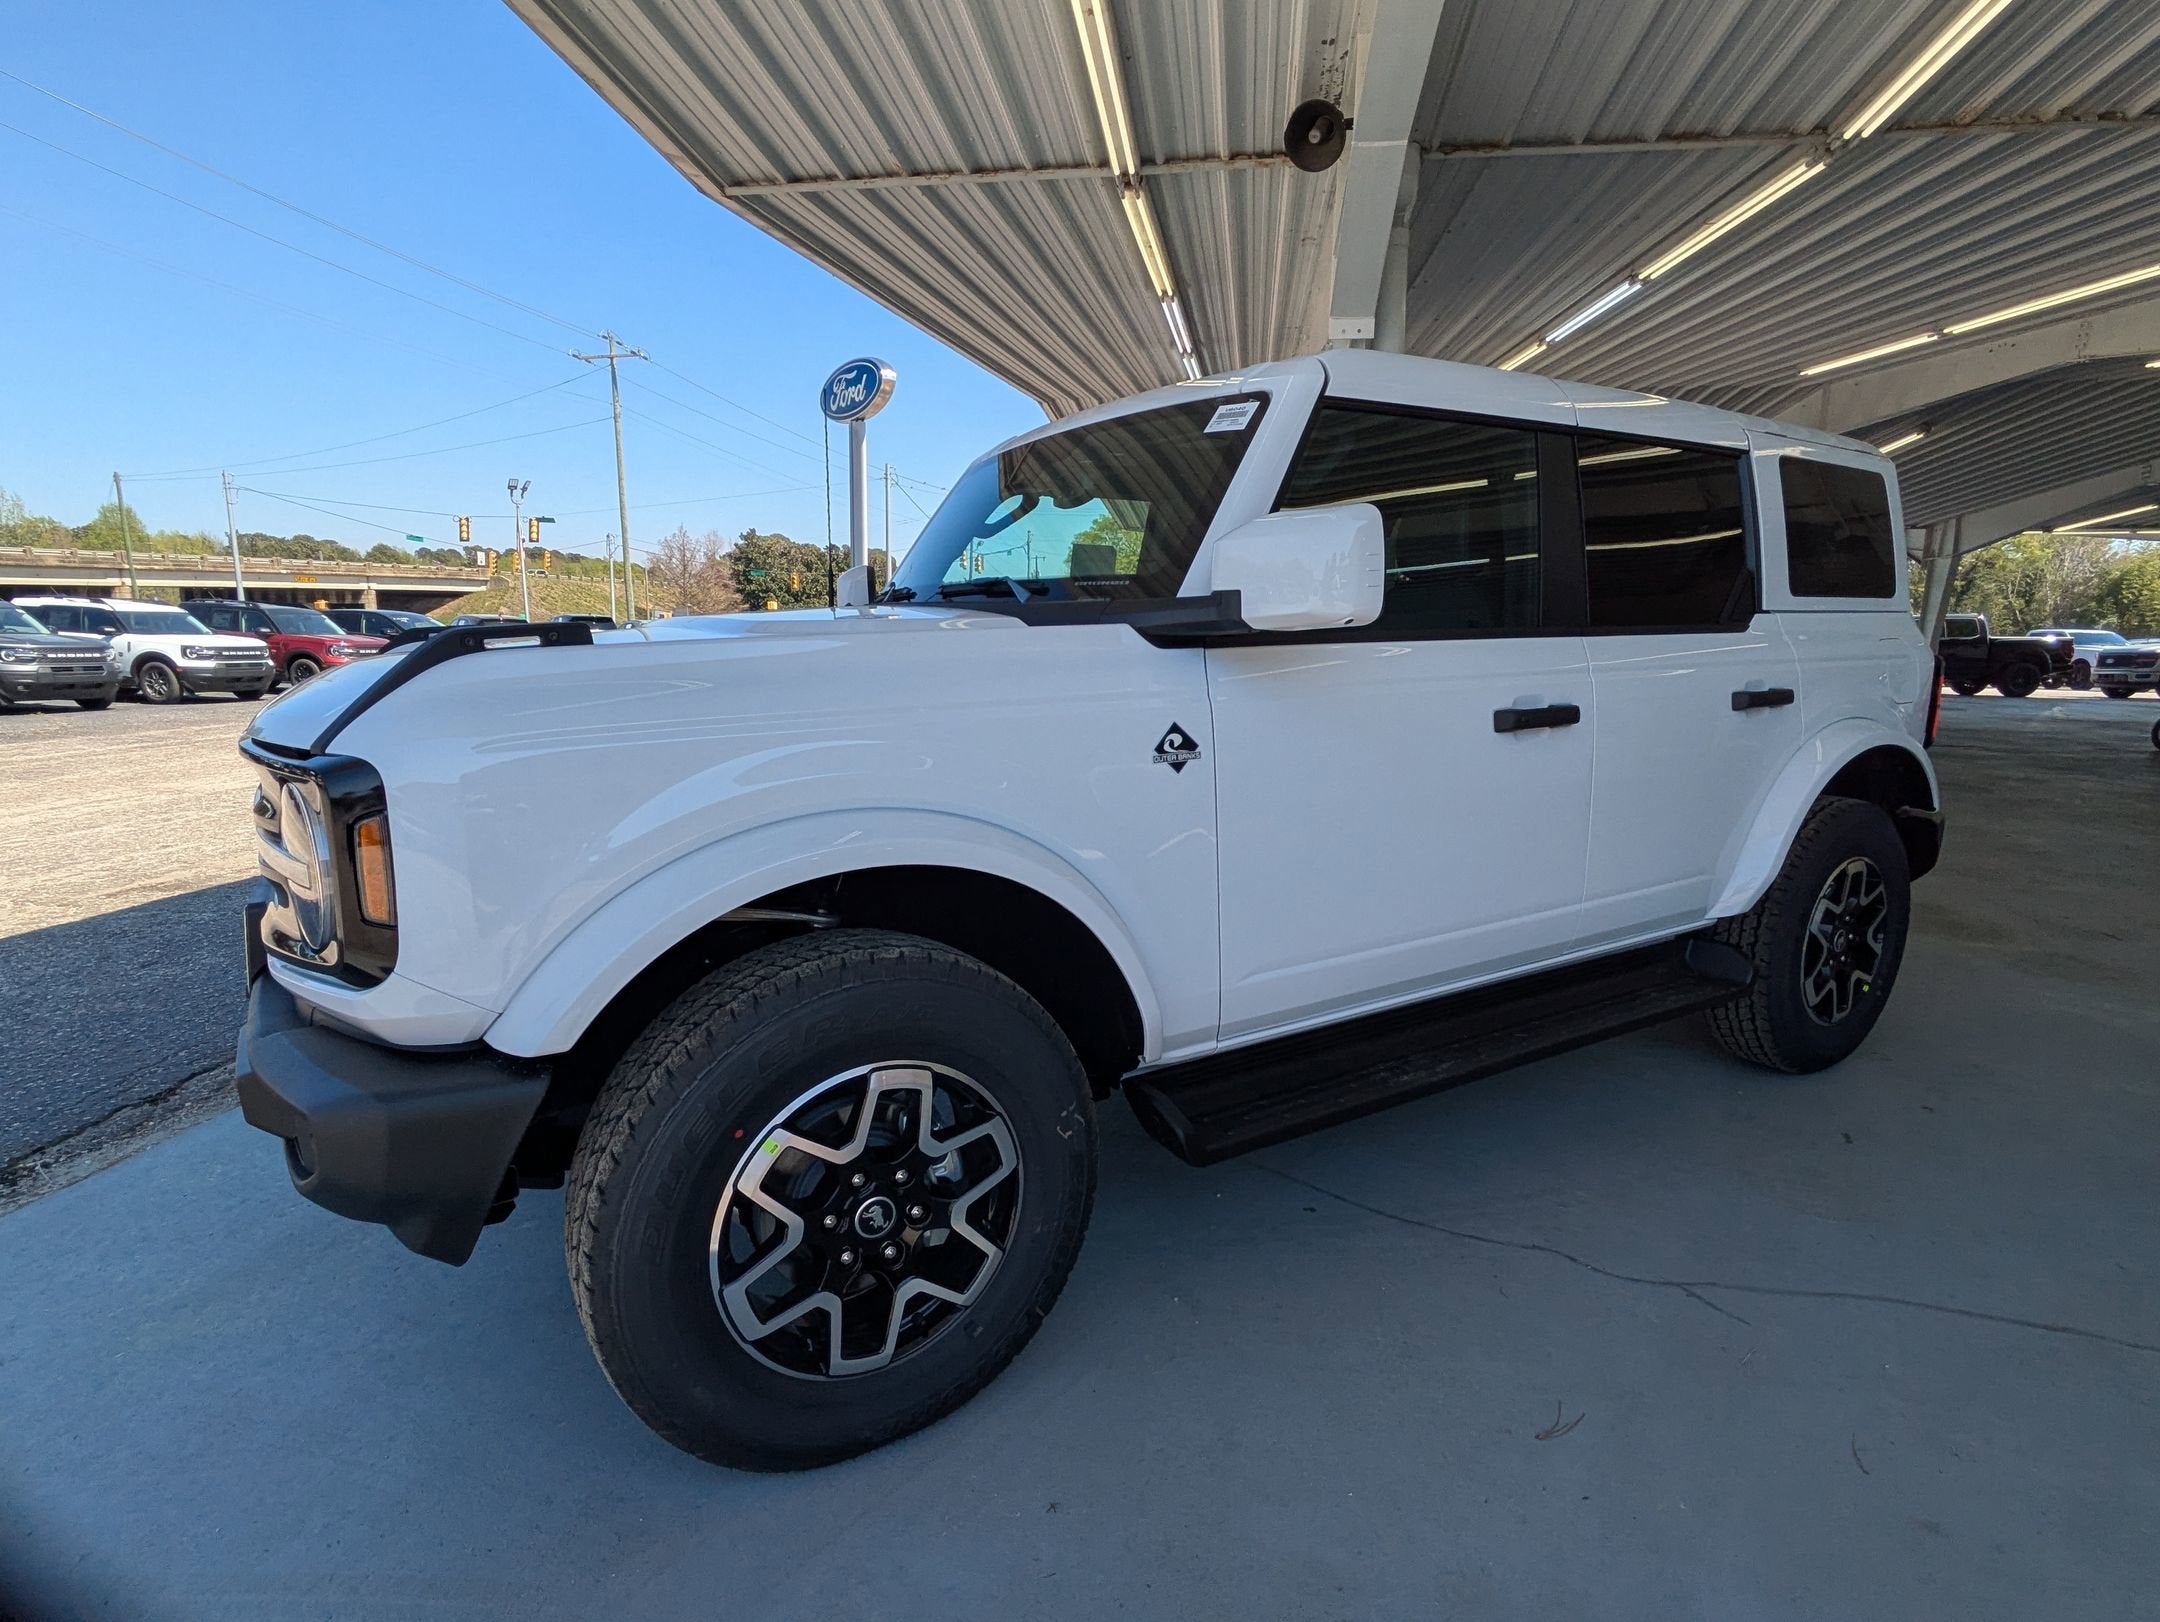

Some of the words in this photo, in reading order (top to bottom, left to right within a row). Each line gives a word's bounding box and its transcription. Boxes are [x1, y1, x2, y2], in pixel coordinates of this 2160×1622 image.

[830, 370, 867, 412] Ford
[1154, 754, 1176, 763] OUTER
[1178, 752, 1201, 760] BANKS
